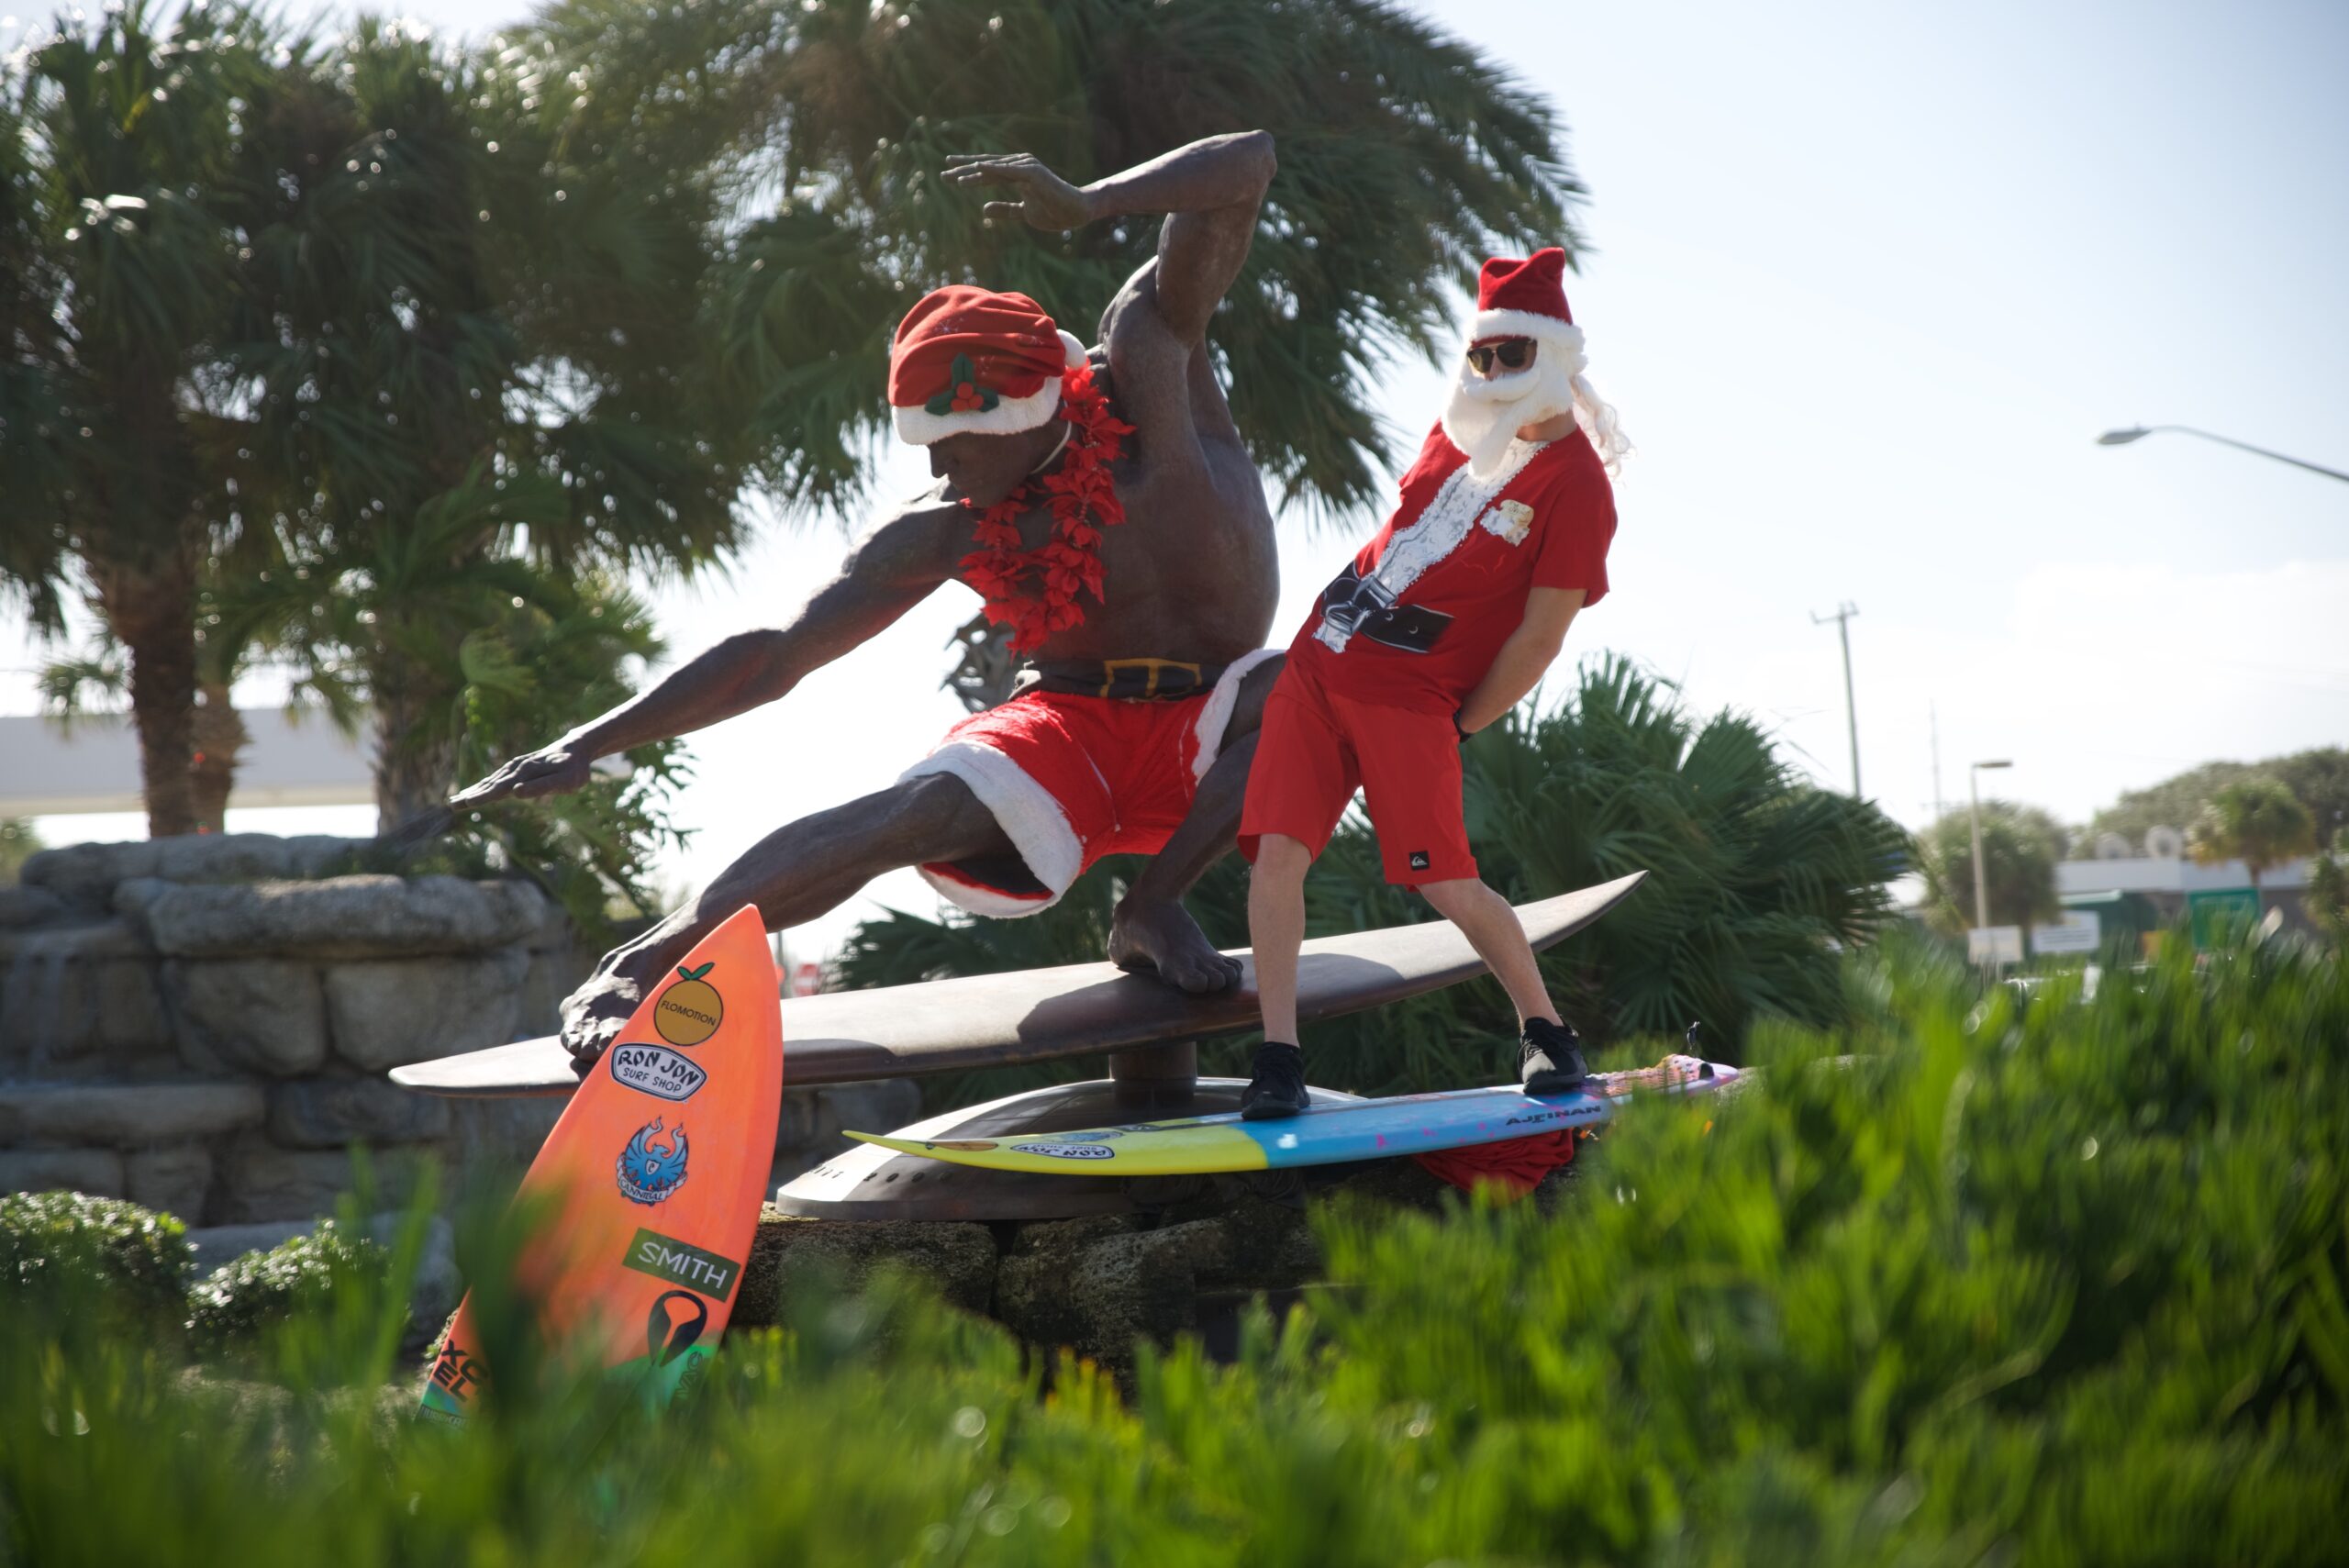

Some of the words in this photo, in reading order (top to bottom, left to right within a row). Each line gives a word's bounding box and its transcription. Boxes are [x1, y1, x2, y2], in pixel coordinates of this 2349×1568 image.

[661, 1000, 717, 1026] FLOMOTION
[618, 1050, 661, 1067] RON
[660, 1060, 700, 1086] JON
[623, 1067, 650, 1082] SURF
[652, 1076, 682, 1093] SHOP
[618, 1178, 664, 1200] CANNIBAL
[638, 1241, 728, 1289] SMITH
